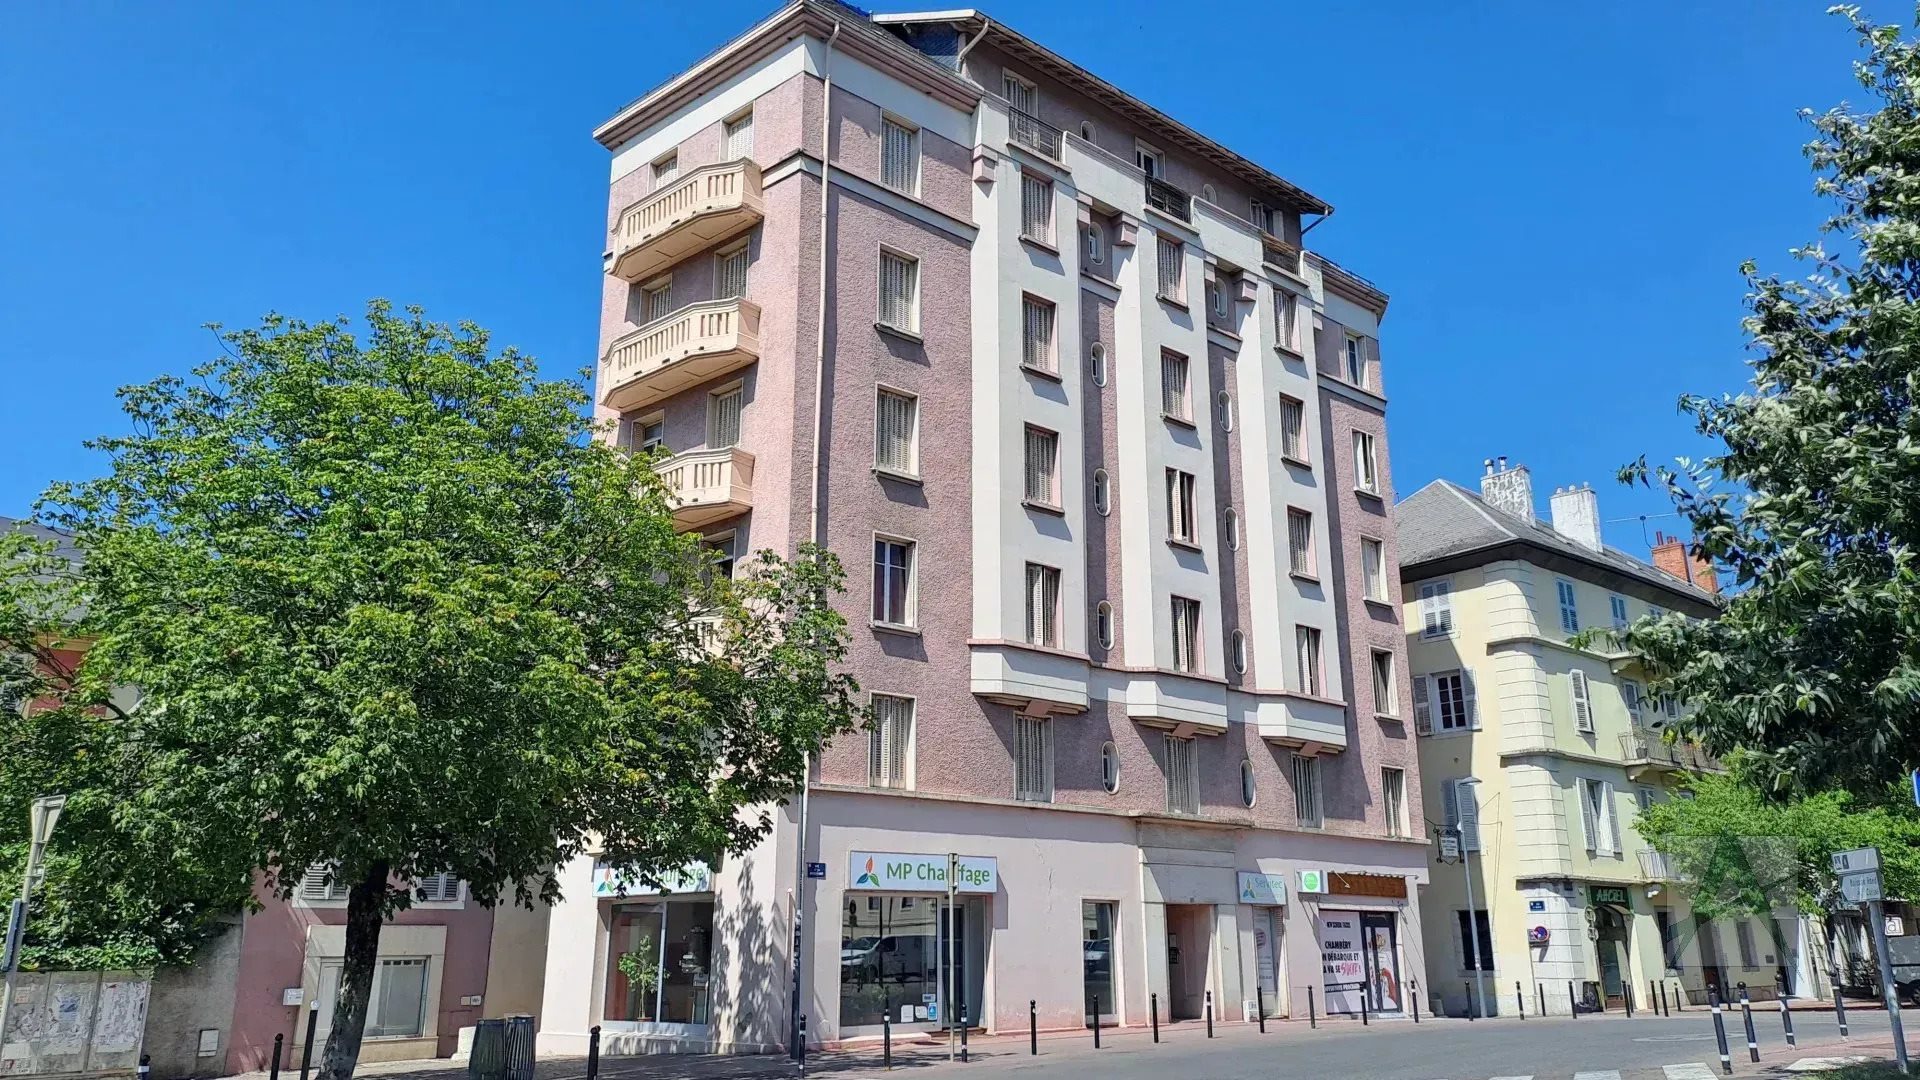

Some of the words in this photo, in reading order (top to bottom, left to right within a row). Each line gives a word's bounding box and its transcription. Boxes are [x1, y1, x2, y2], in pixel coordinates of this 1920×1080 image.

[886, 862, 912, 880] MP
[917, 863, 990, 886] Chafage
[1325, 939, 1351, 949] CHAMBÉRY
